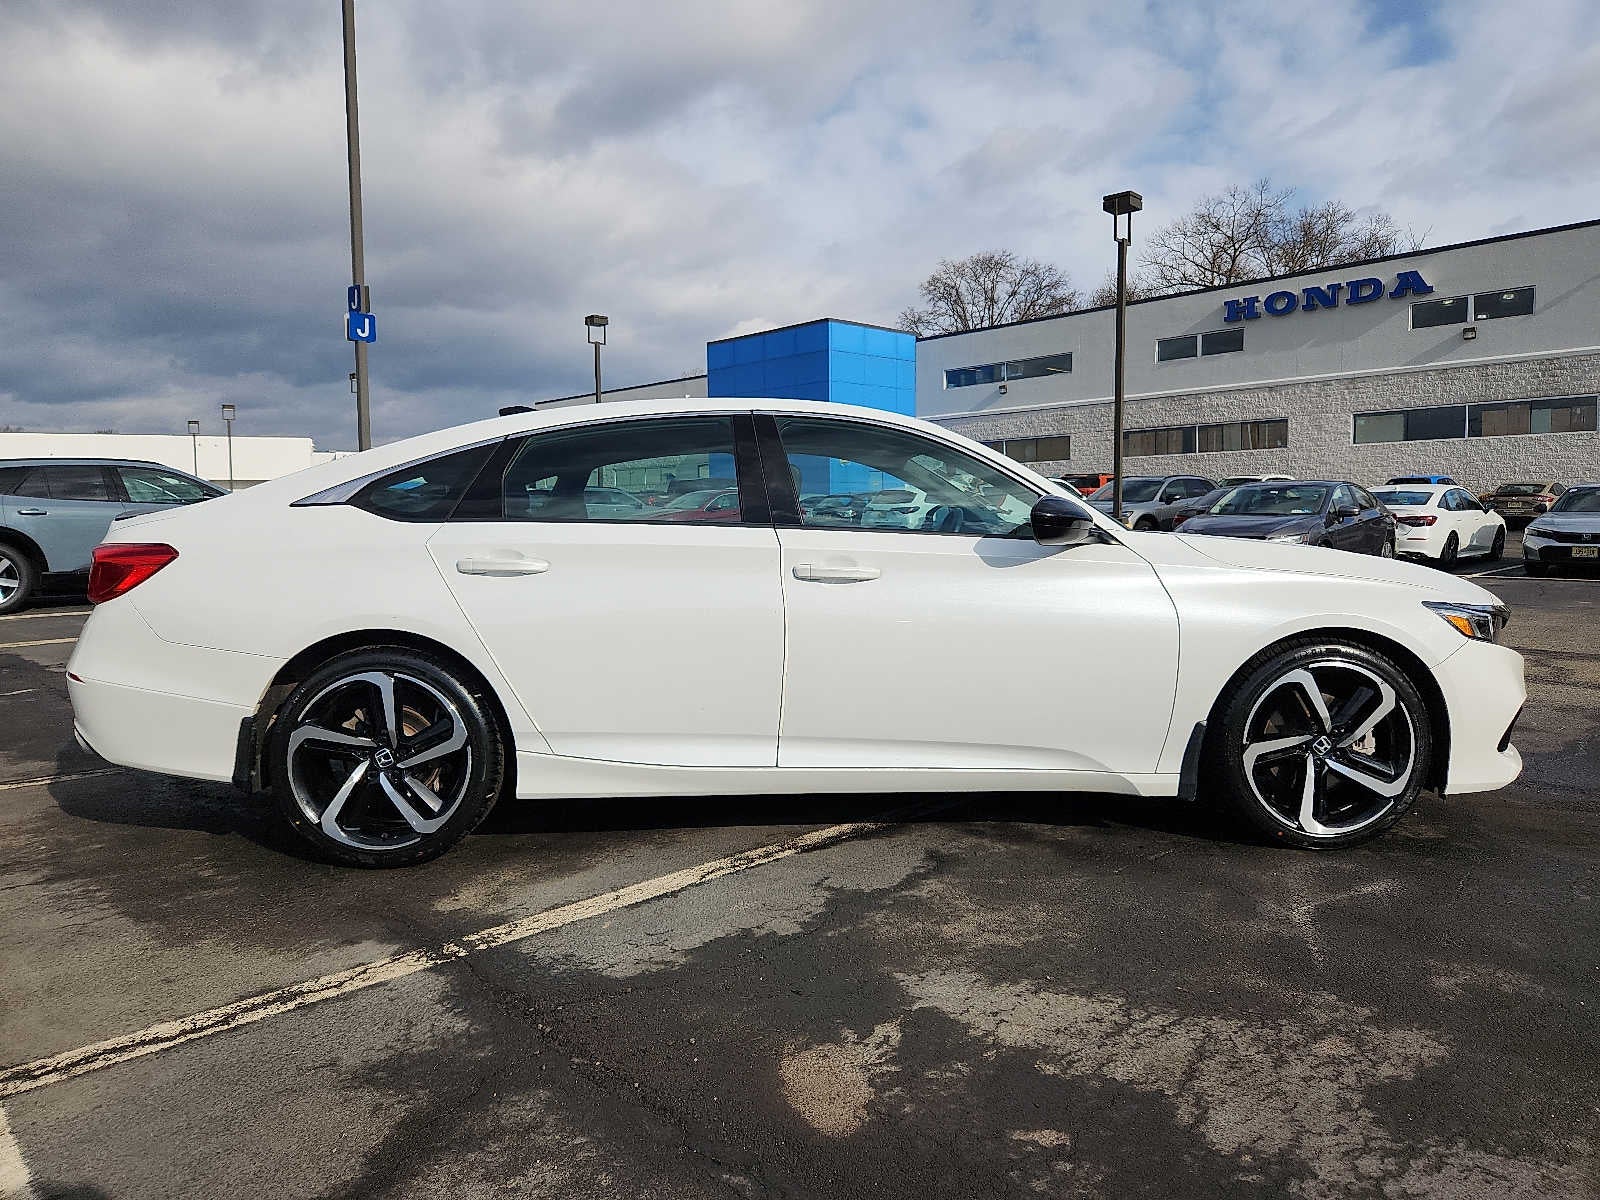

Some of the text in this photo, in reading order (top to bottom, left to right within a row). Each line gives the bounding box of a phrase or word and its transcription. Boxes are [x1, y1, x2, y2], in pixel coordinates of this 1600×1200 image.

[352, 289, 358, 309] J
[1223, 270, 1434, 322] HONDA
[356, 318, 370, 337] J
